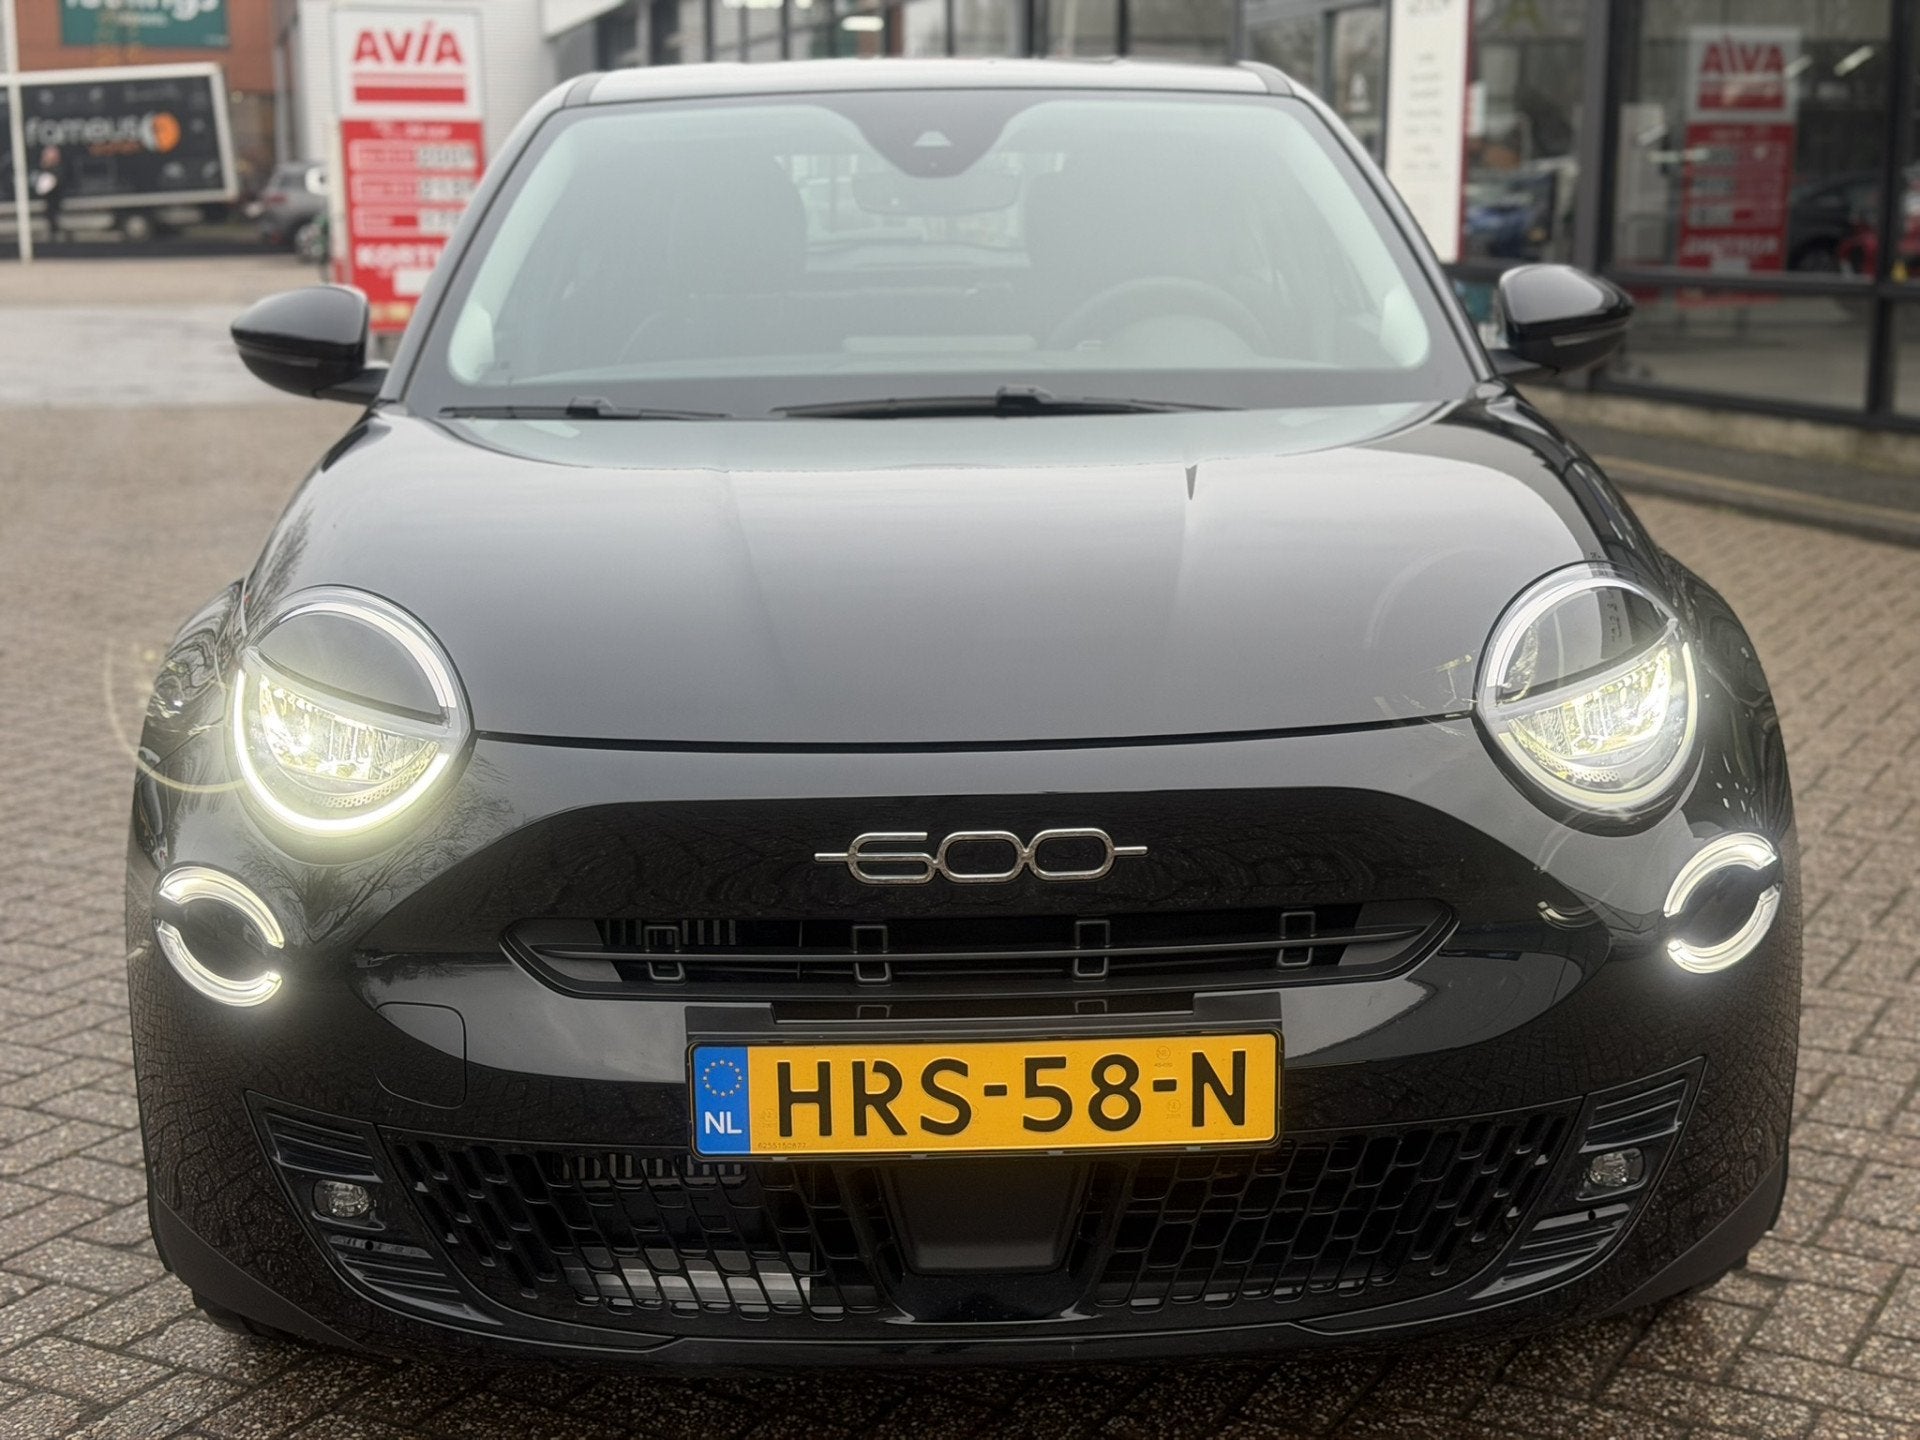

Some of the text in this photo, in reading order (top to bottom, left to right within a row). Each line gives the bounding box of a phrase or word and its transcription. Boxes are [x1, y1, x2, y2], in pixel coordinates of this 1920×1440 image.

[354, 20, 464, 63] AVIA
[848, 828, 1115, 884] 600
[777, 1050, 1247, 1138] HRS-58-N
[704, 1110, 742, 1135] NL
